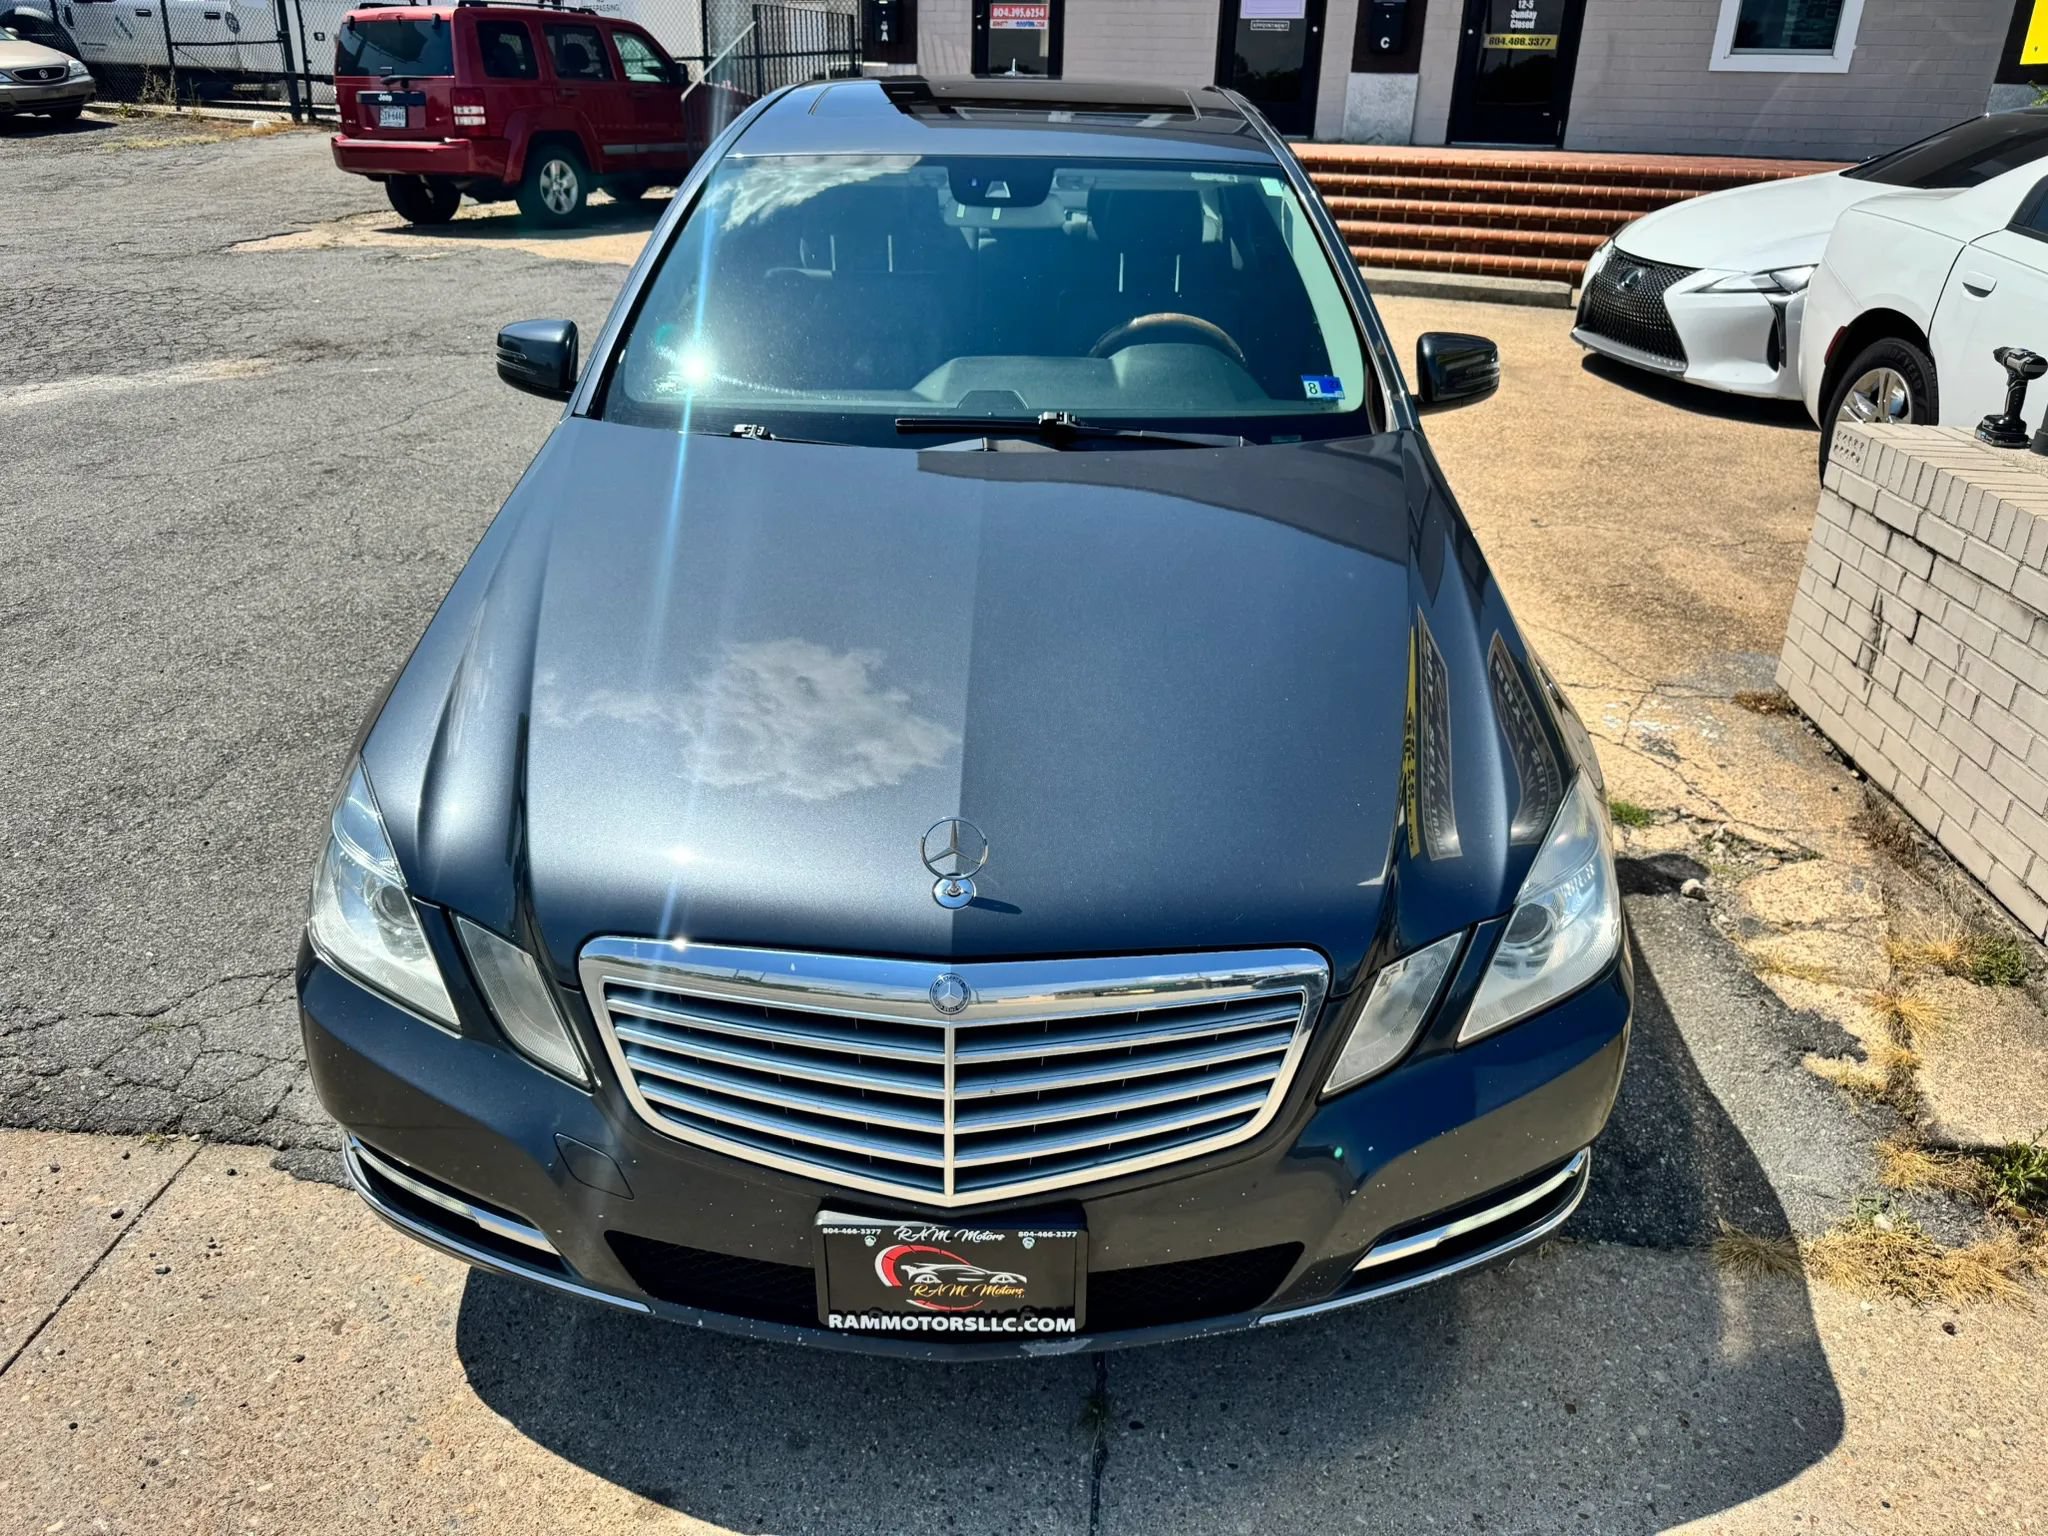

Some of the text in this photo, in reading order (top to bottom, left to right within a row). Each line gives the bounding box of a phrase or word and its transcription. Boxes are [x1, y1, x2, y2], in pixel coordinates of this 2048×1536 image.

[1510, 9, 1538, 20] Sunday
[1510, 20, 1535, 29] Closed
[1380, 36, 1390, 49] C
[1308, 382, 1318, 395] 8
[893, 1225, 1006, 1243] RAM Motors
[909, 1283, 1025, 1298] RAM Motors
[828, 1313, 1076, 1333] RAMMOTORSLLC.COM
